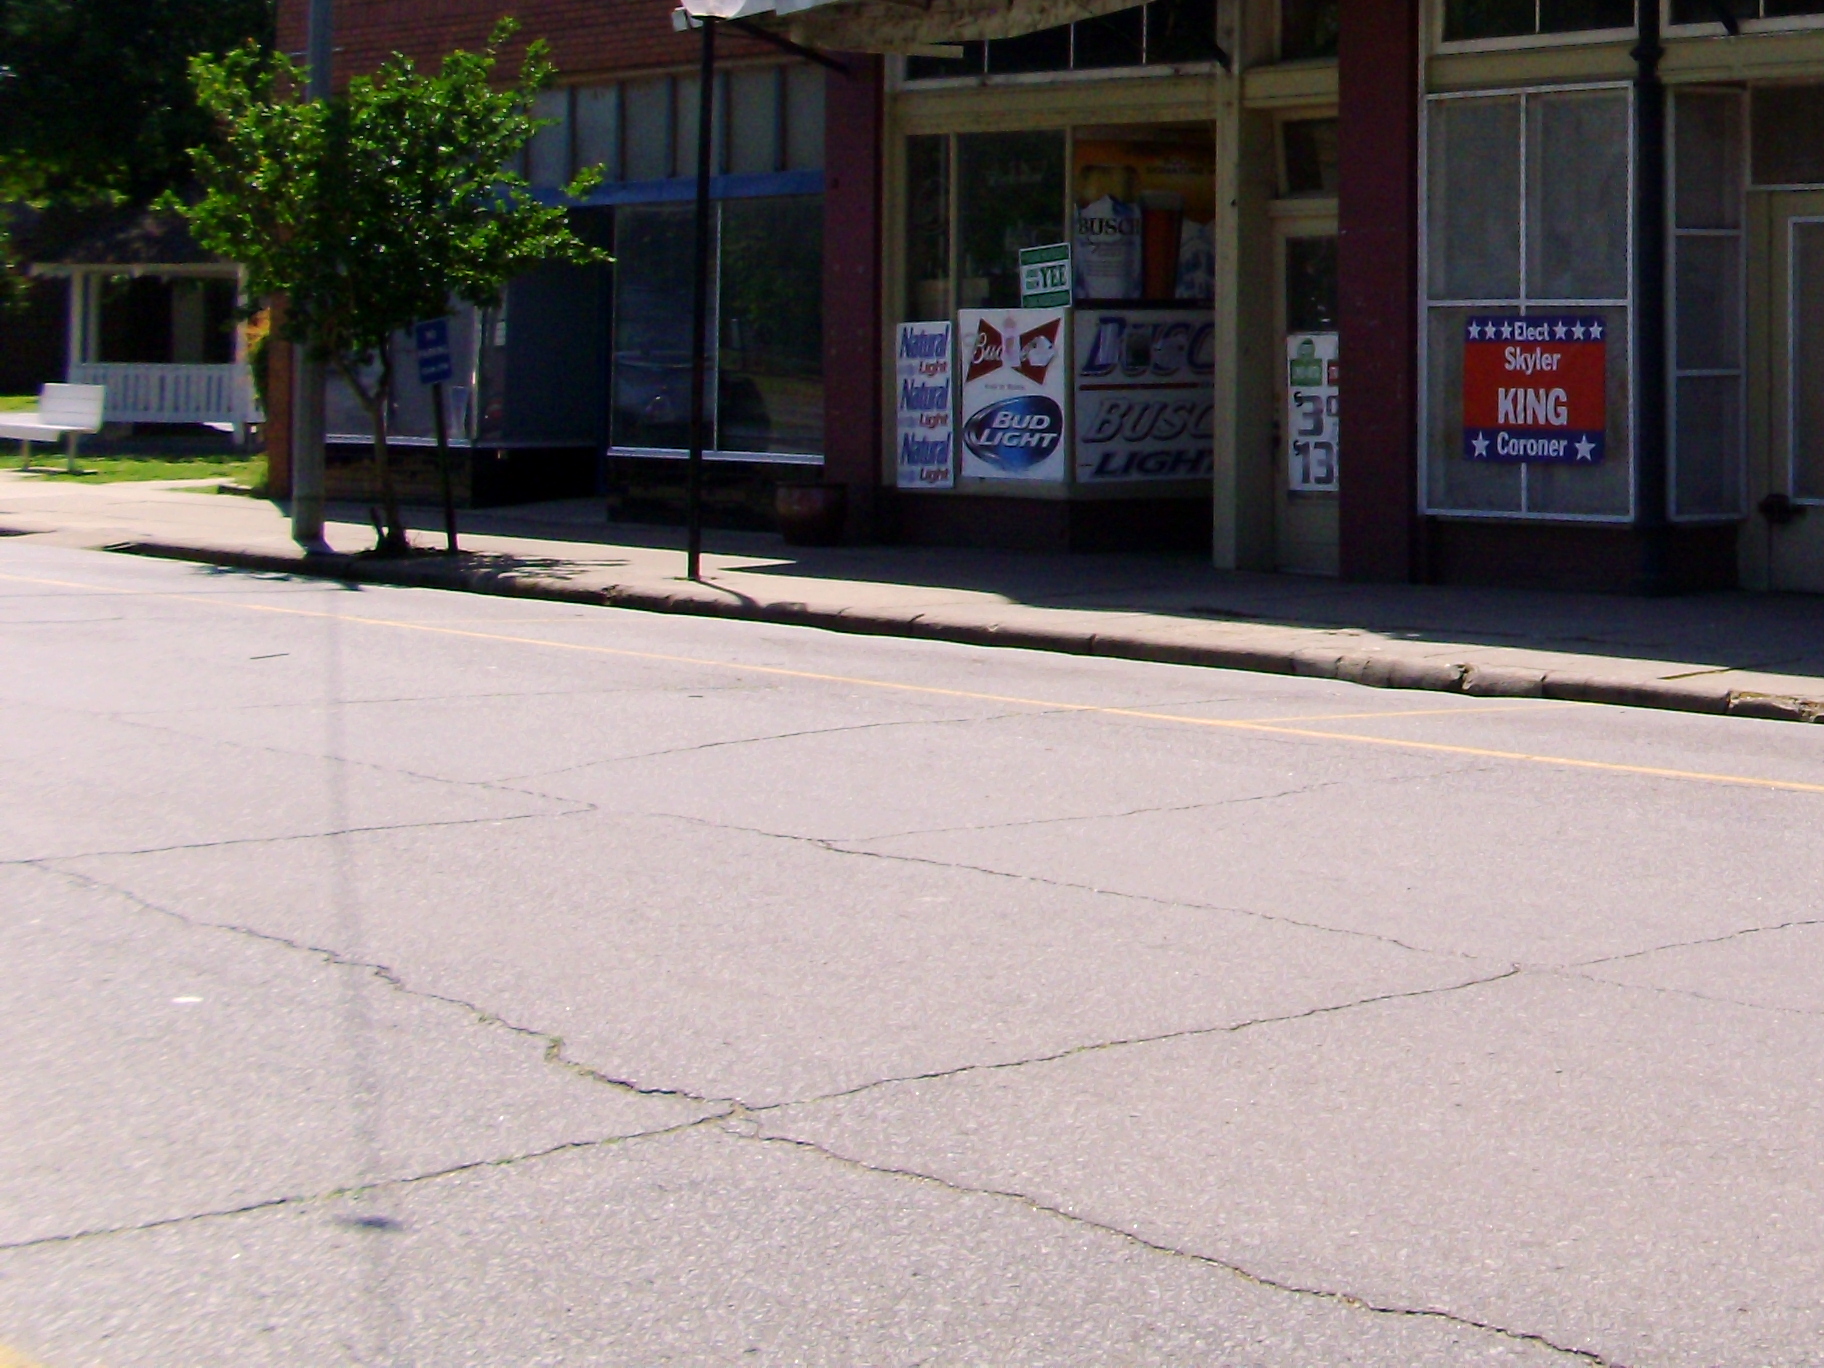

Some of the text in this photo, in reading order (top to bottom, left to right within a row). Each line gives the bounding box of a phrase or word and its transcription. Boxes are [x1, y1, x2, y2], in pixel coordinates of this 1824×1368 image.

[1040, 264, 1067, 288] YEE
[900, 324, 949, 359] Natural
[1513, 321, 1551, 341] Elect
[919, 361, 948, 377] Light
[1504, 346, 1561, 375] Skyler
[901, 378, 950, 410] Natural
[1497, 387, 1568, 425] KING
[919, 413, 949, 428] Light
[991, 410, 1050, 430] BUD
[902, 432, 951, 465] Natural
[977, 428, 1058, 448] LIGHT
[1496, 431, 1568, 457] Coroner
[919, 468, 949, 483] Light
